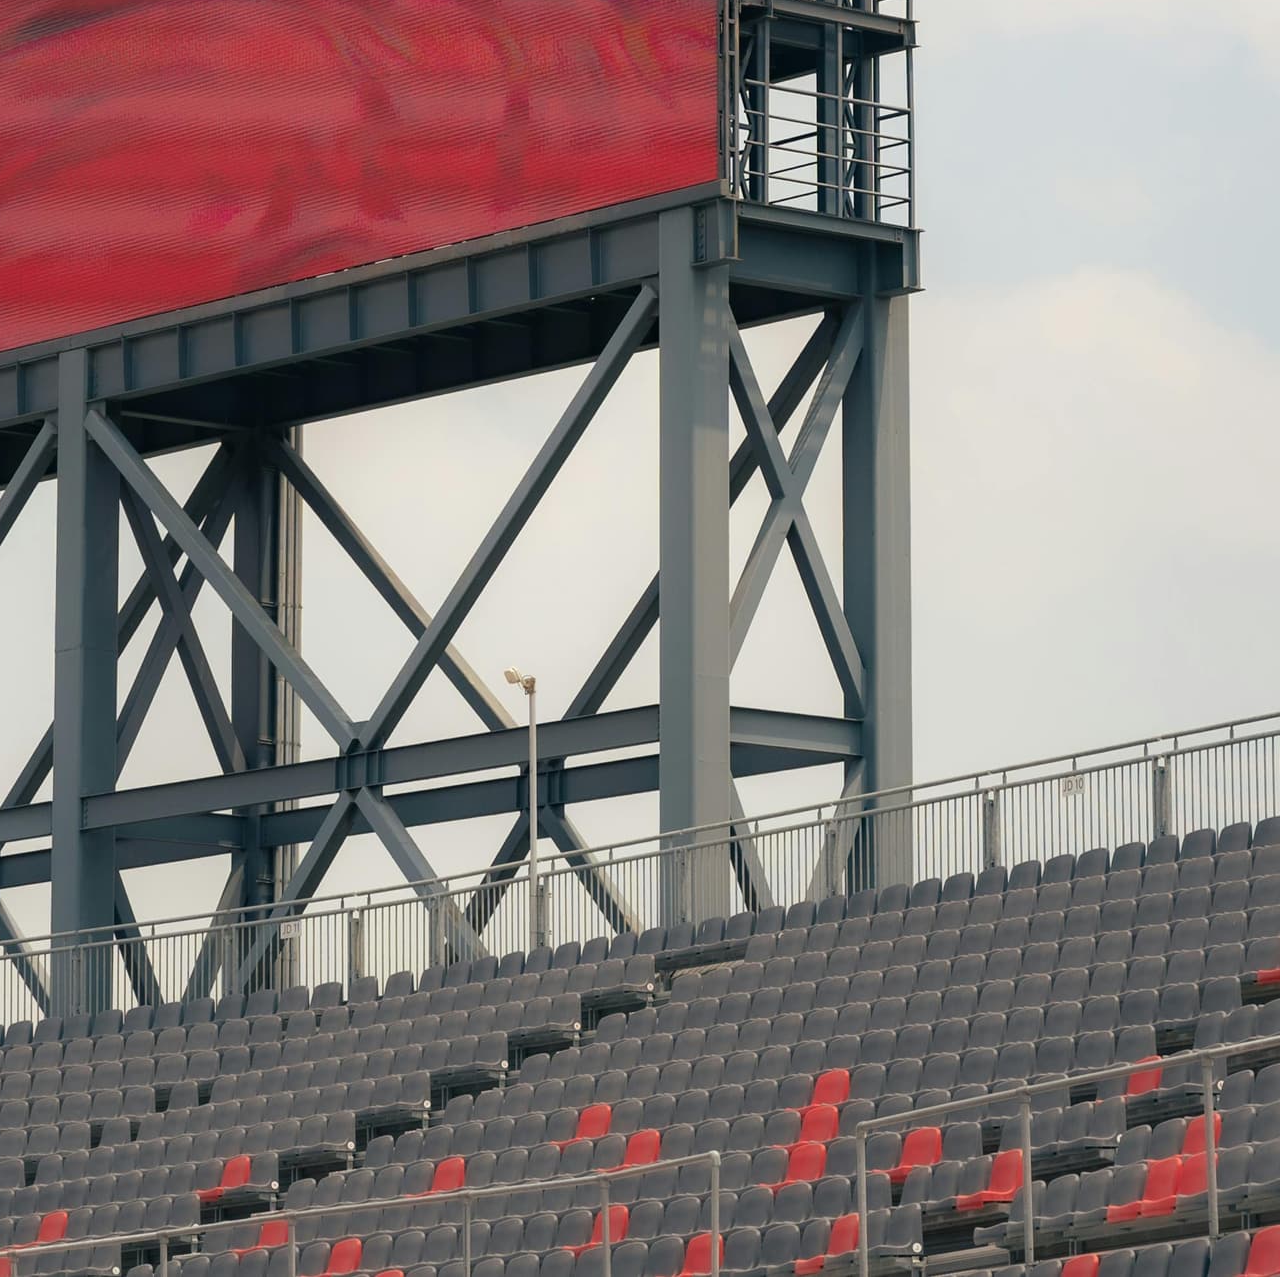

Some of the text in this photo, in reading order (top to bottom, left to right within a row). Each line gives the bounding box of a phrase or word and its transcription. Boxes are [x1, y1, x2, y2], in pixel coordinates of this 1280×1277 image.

[1063, 776, 1084, 793] JD 10
[282, 923, 292, 935] JD
